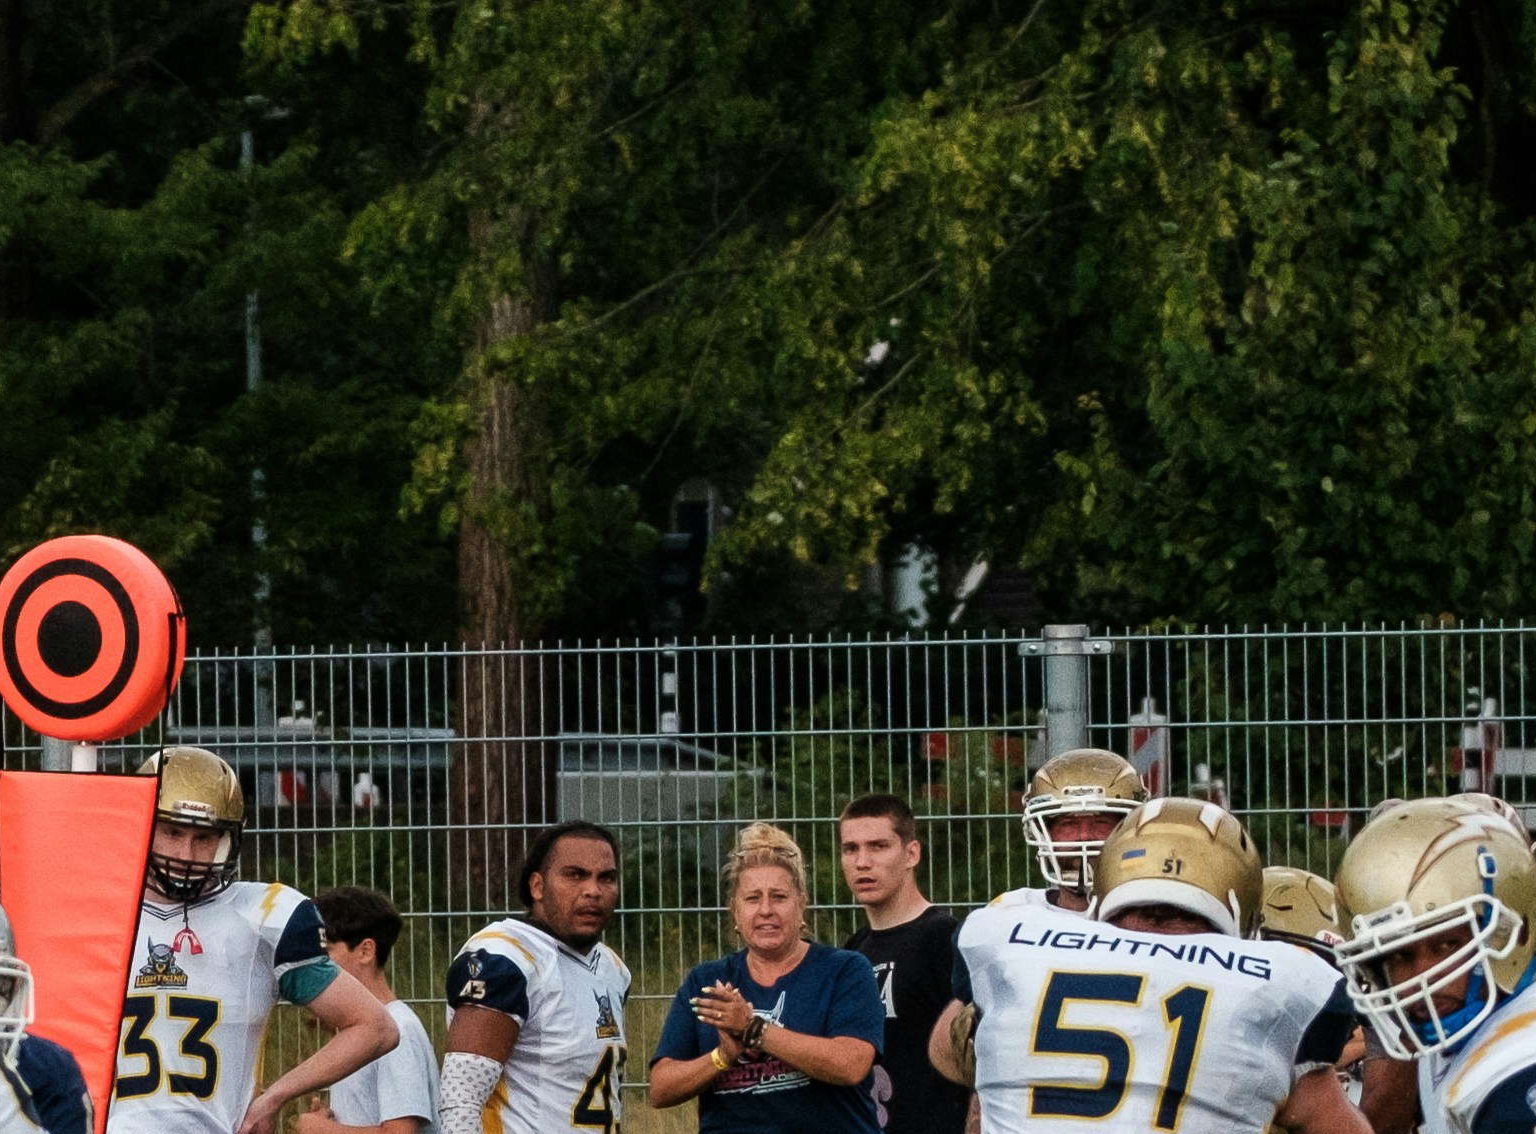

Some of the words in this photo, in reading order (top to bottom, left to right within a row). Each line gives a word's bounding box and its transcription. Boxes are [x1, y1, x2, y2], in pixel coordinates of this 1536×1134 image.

[1162, 858, 1182, 876] 51
[1008, 921, 1272, 981] LIGHTNING
[114, 993, 222, 1102] 33
[1027, 967, 1214, 1134] 51
